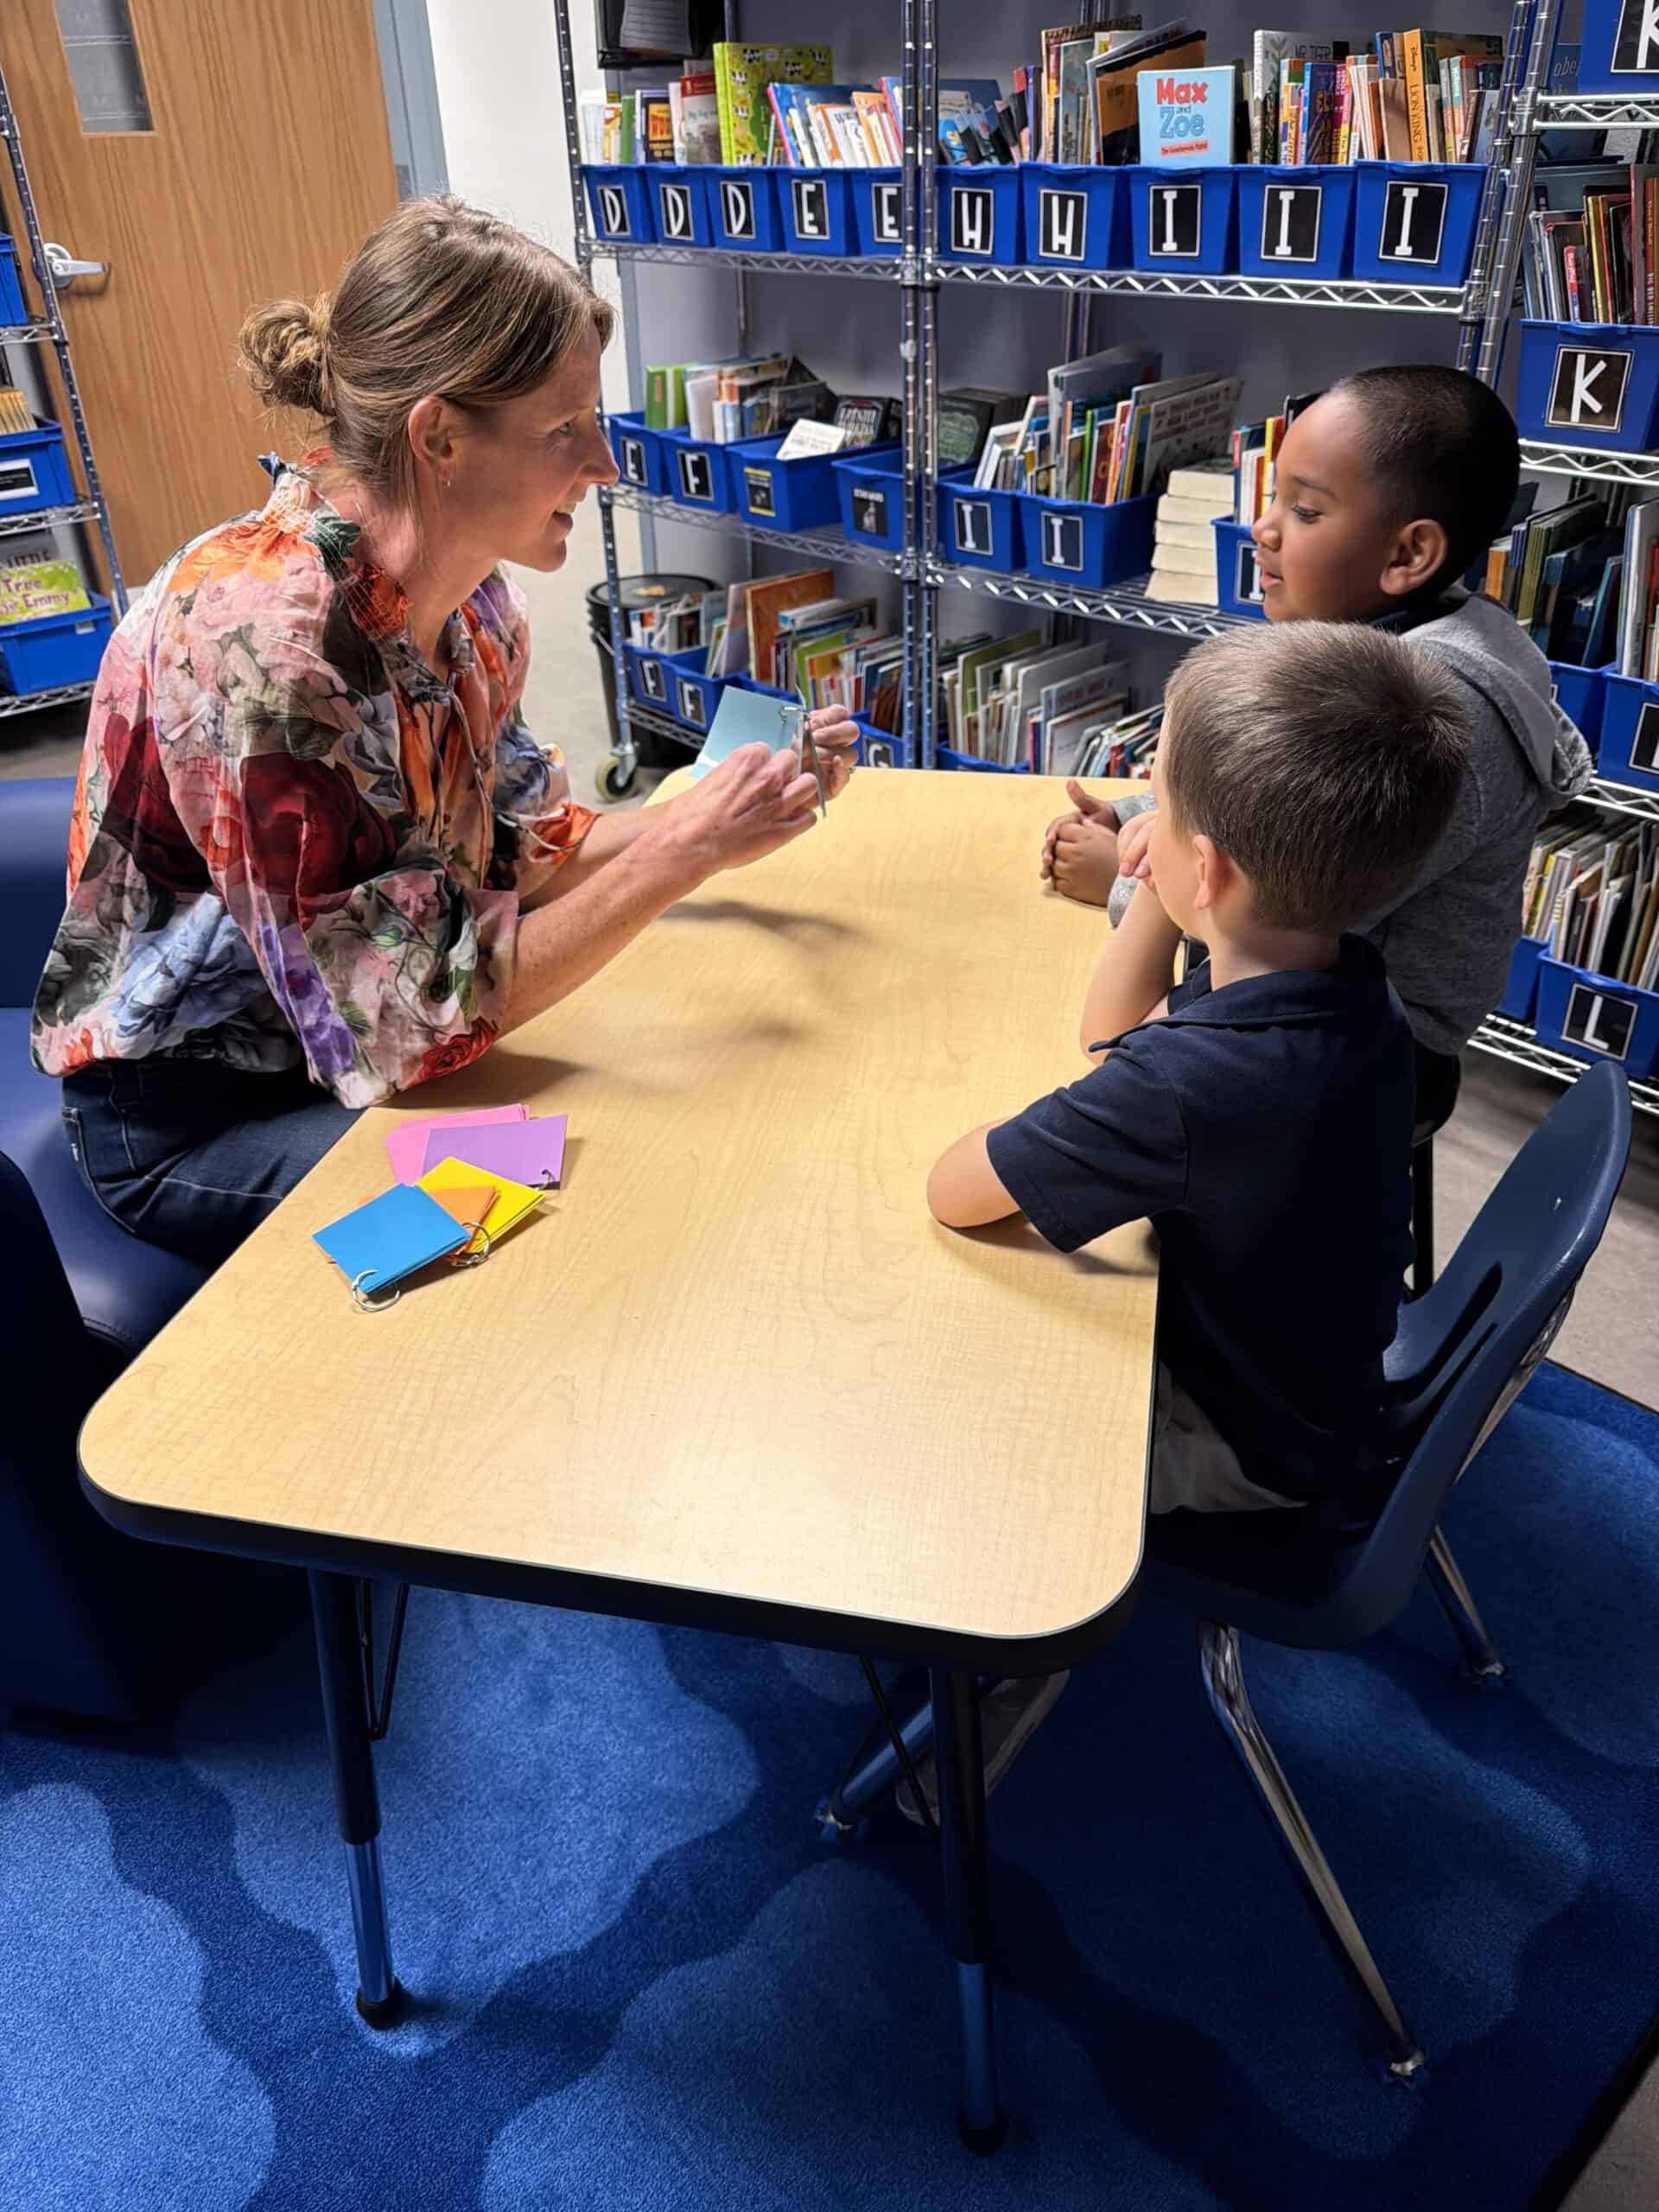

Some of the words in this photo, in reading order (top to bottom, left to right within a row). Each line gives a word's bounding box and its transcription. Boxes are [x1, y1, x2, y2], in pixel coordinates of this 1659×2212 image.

[1156, 78, 1208, 105] Max
[1176, 105, 1192, 114] and
[1160, 106, 1205, 138] Zoe
[603, 189, 620, 232] D
[666, 188, 684, 236] D
[727, 184, 745, 235] D
[801, 183, 819, 235] E
[881, 187, 899, 238] E
[1162, 190, 1178, 251] I
[1274, 190, 1295, 256] I
[1395, 187, 1419, 256] I
[1570, 353, 1608, 423] K
[626, 442, 639, 480] E
[687, 454, 701, 494] F
[961, 504, 976, 549] I
[1051, 518, 1065, 563] I
[3, 578, 42, 594] Tree
[22, 593, 69, 608] Emmy
[644, 664, 658, 699] F
[683, 684, 698, 722] F
[1583, 995, 1610, 1051] L
